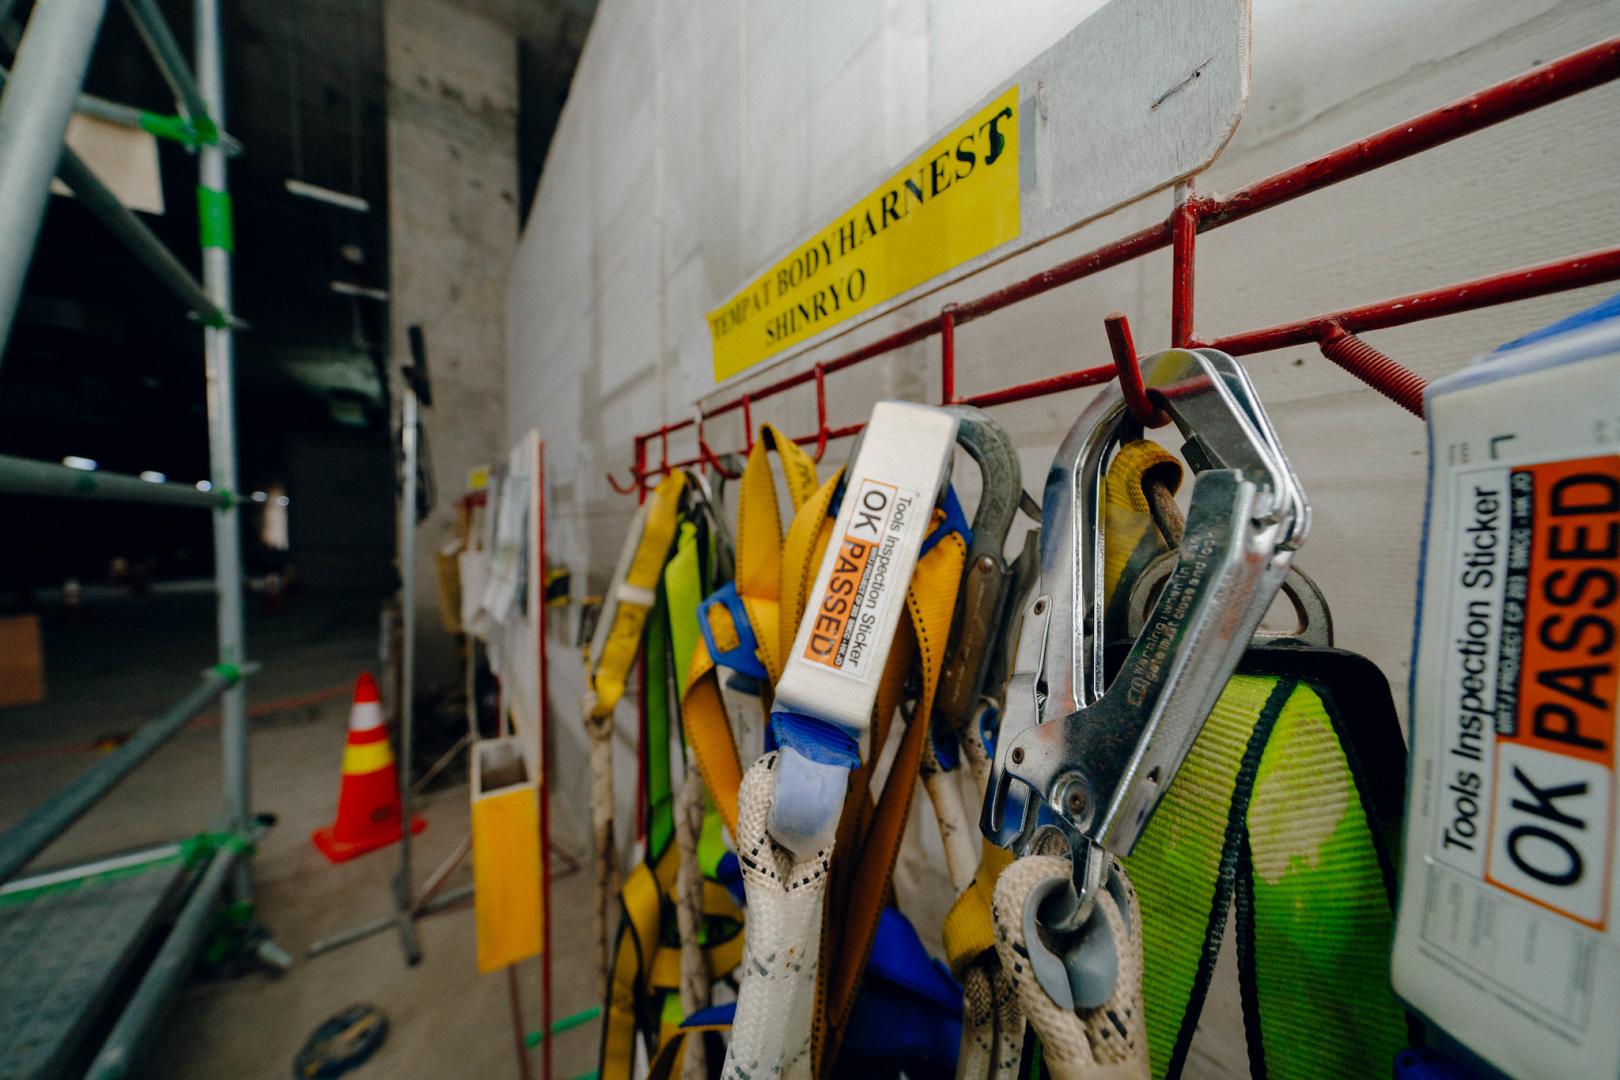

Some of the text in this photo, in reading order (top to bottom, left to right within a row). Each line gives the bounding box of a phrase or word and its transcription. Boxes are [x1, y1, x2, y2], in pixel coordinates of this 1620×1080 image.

[712, 278, 771, 339] TEMPAT
[764, 268, 865, 346] SHINRYO
[853, 490, 888, 536] OK
[888, 497, 913, 532] Tools
[810, 541, 867, 656] PASSED
[865, 535, 900, 609] Inspection
[848, 613, 876, 668] Sticker
[1443, 486, 1499, 852] Tools Inspection Sticker
[1506, 473, 1620, 887] OK PASSED
